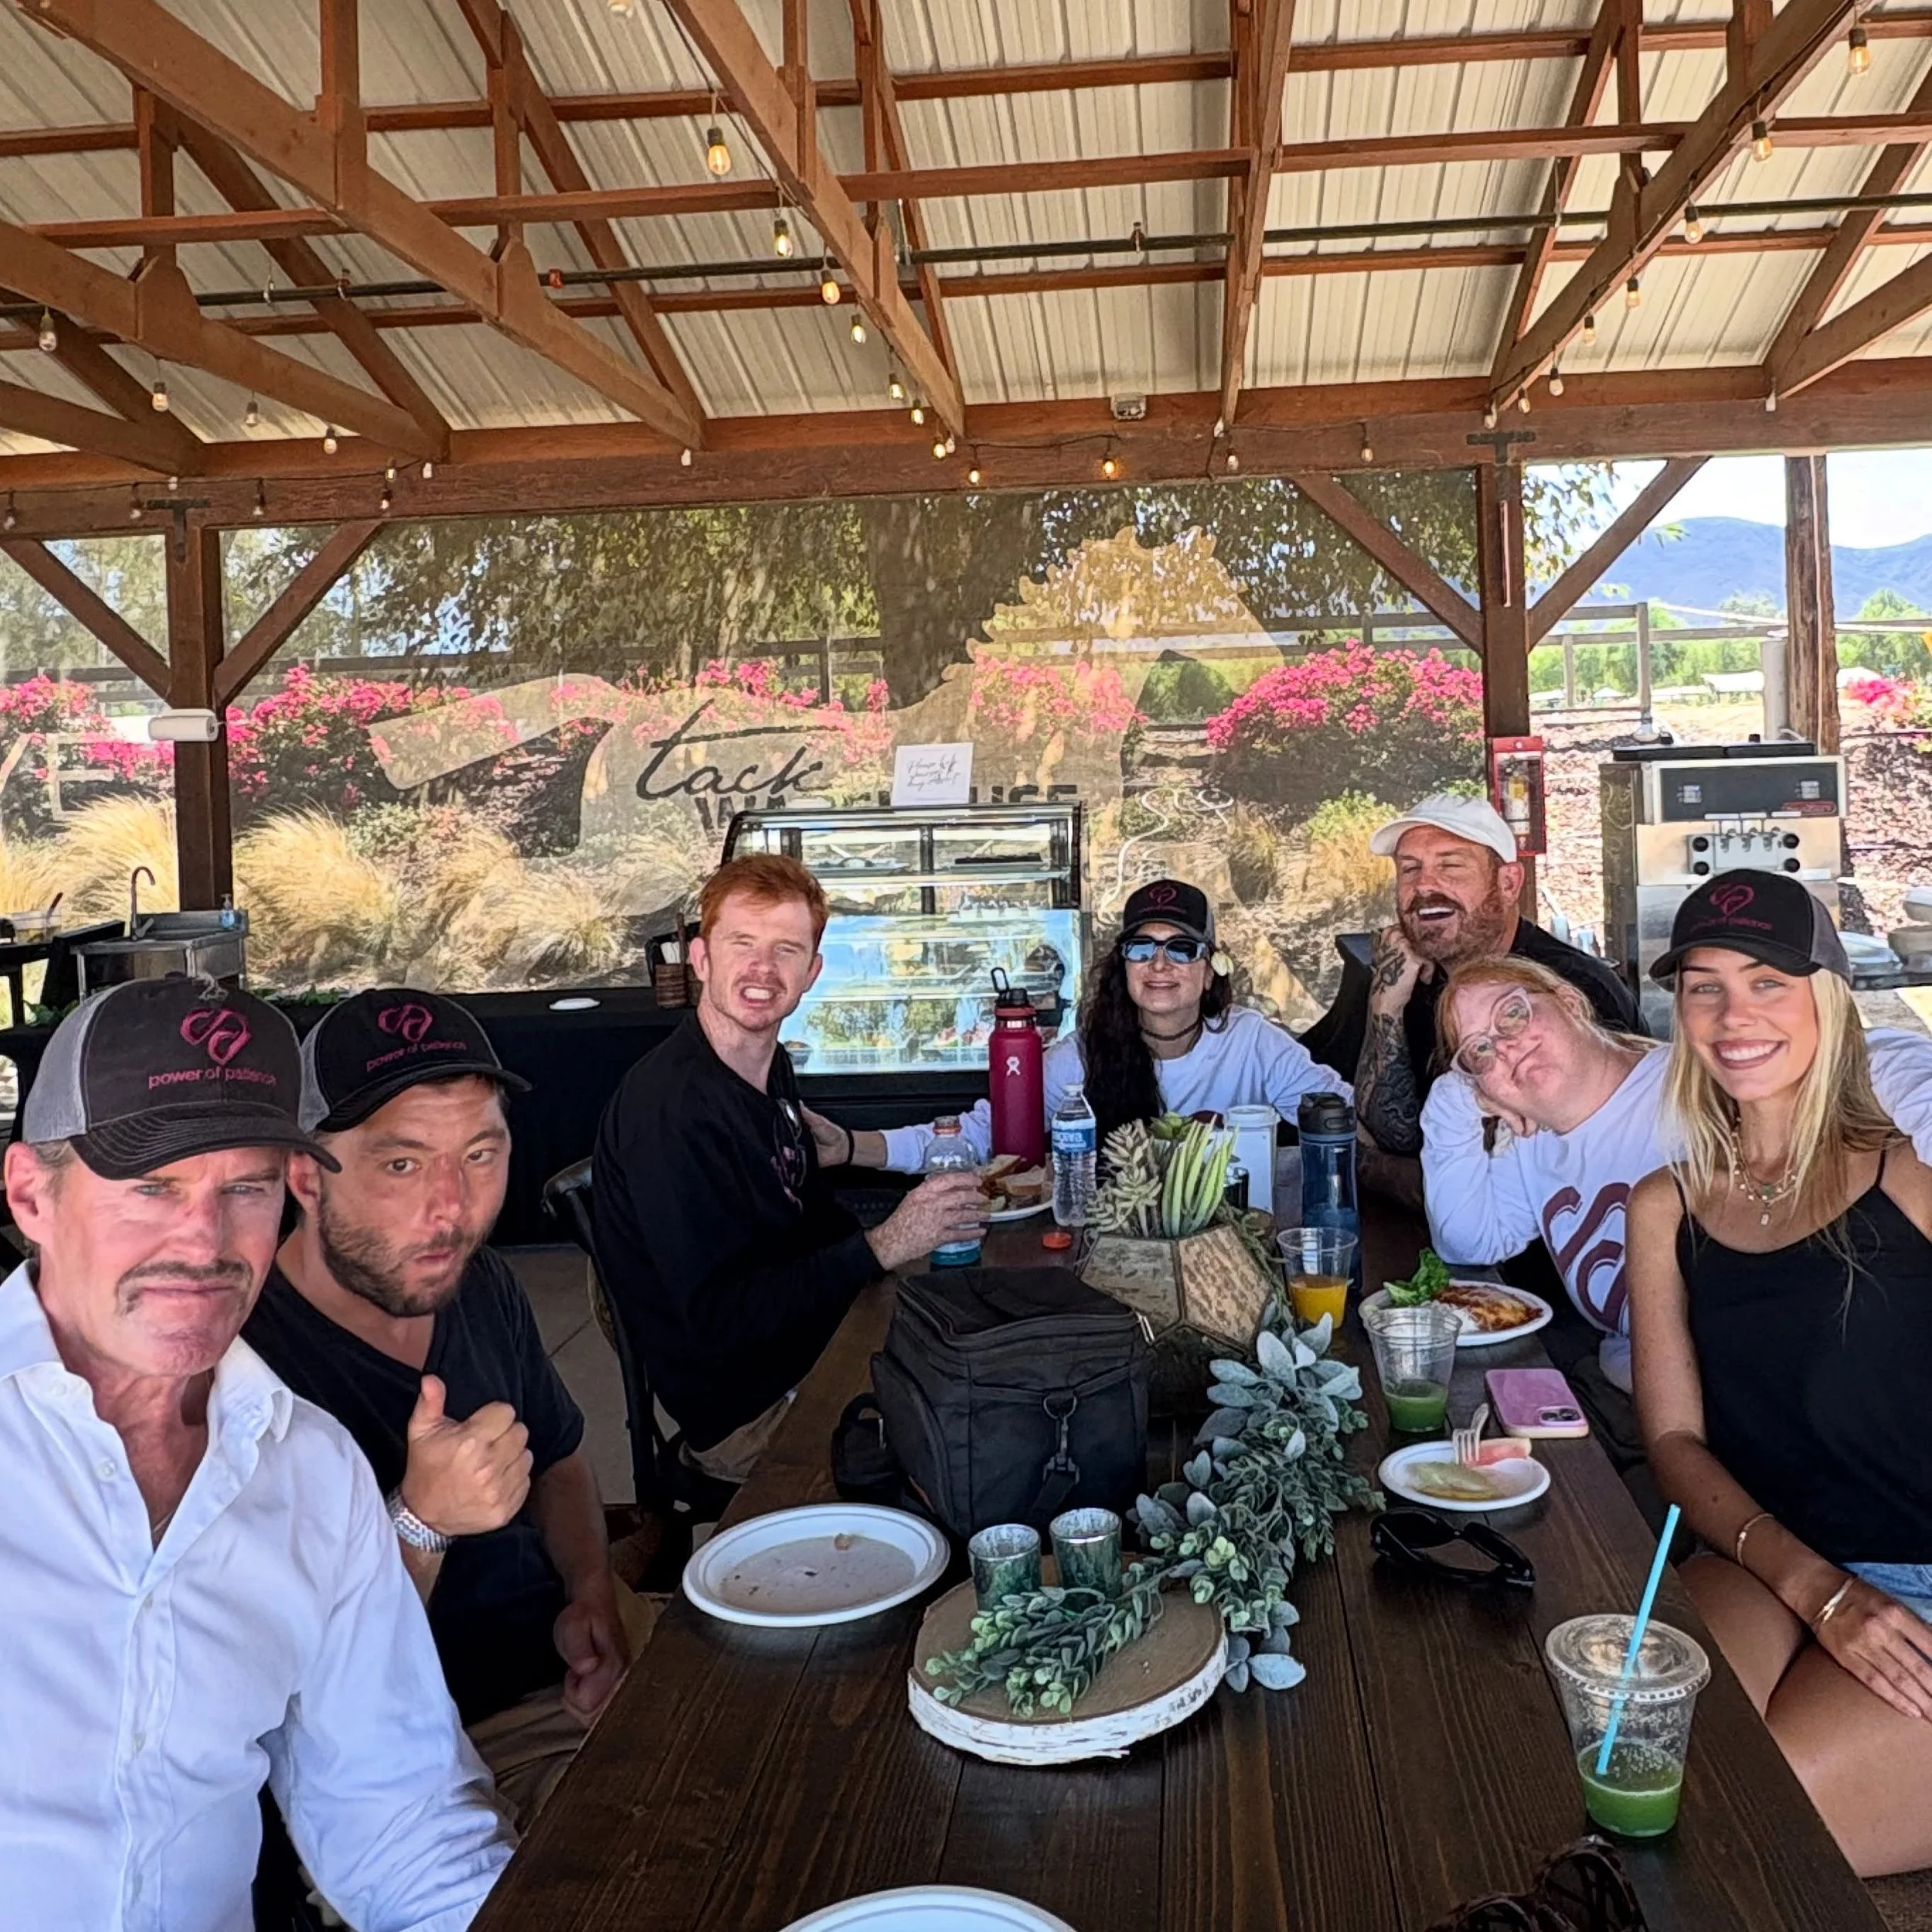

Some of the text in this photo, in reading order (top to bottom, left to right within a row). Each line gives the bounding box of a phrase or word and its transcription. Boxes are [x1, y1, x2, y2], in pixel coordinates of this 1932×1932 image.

[635, 698, 844, 800] tack
[148, 1070, 203, 1090] power
[206, 1066, 222, 1080] of
